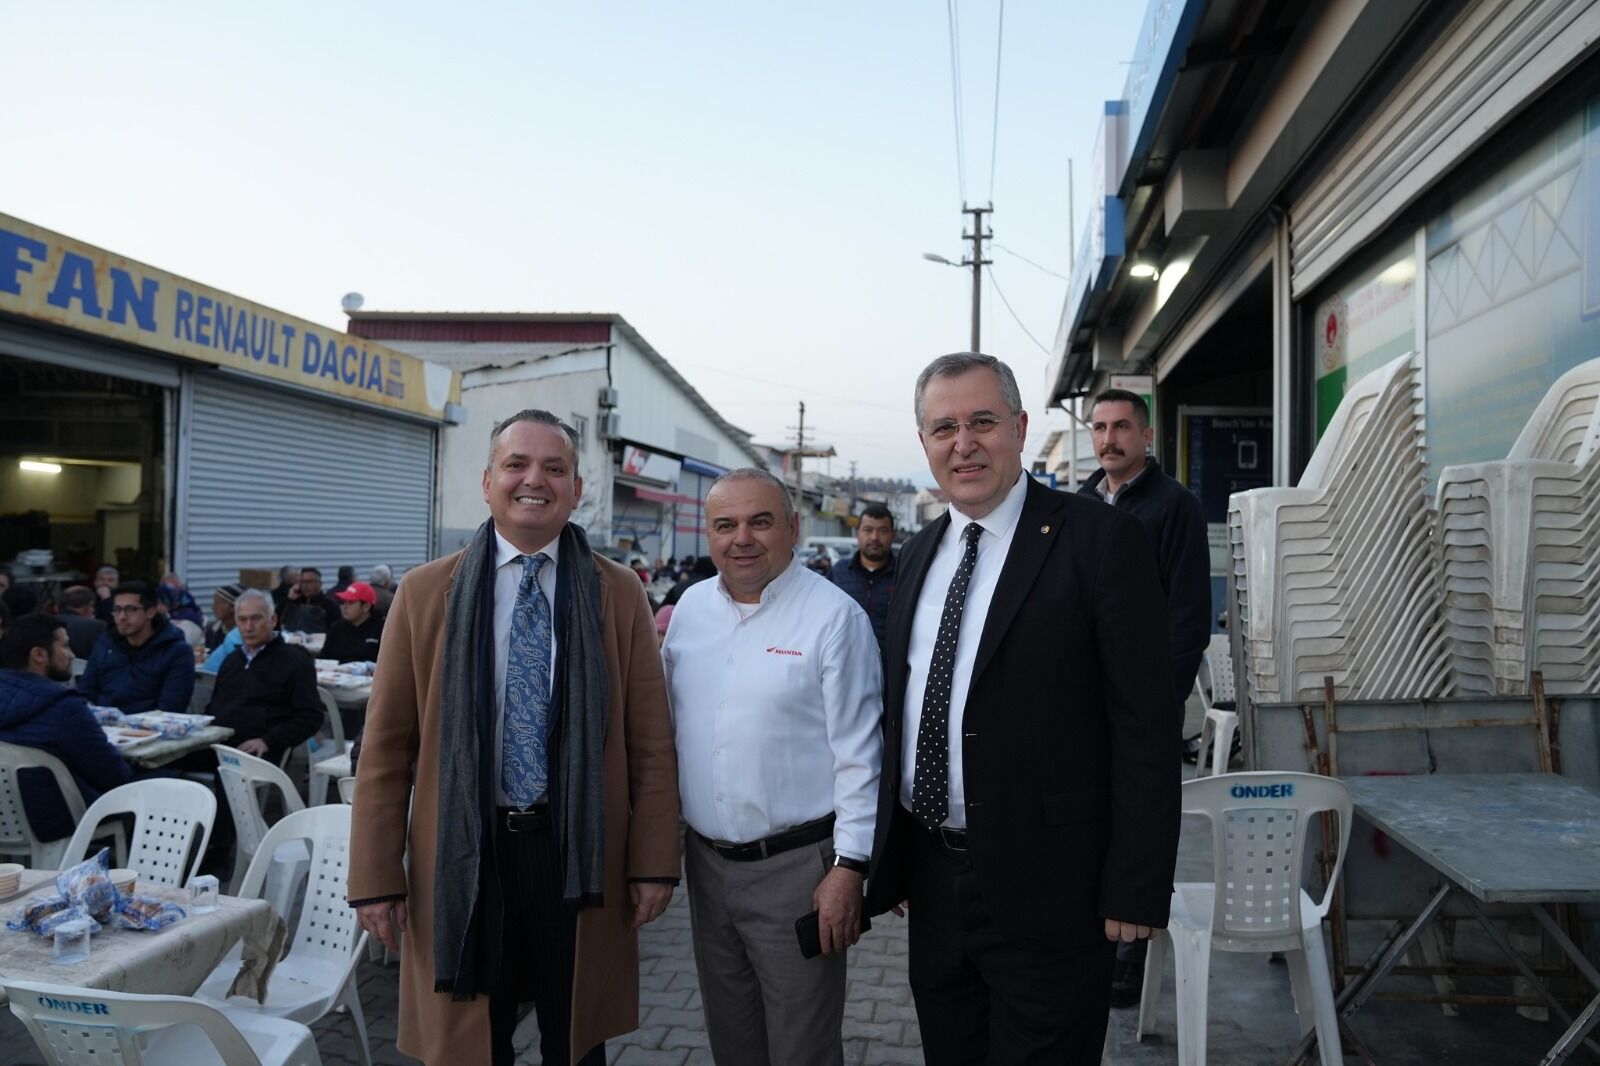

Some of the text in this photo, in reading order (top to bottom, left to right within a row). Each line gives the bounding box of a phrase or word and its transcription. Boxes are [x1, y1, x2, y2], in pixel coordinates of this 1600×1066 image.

[0, 228, 384, 393] FAN RENAULT DACİA
[1231, 783, 1293, 798] ÖNDER
[38, 993, 109, 1015] ÖNDER
